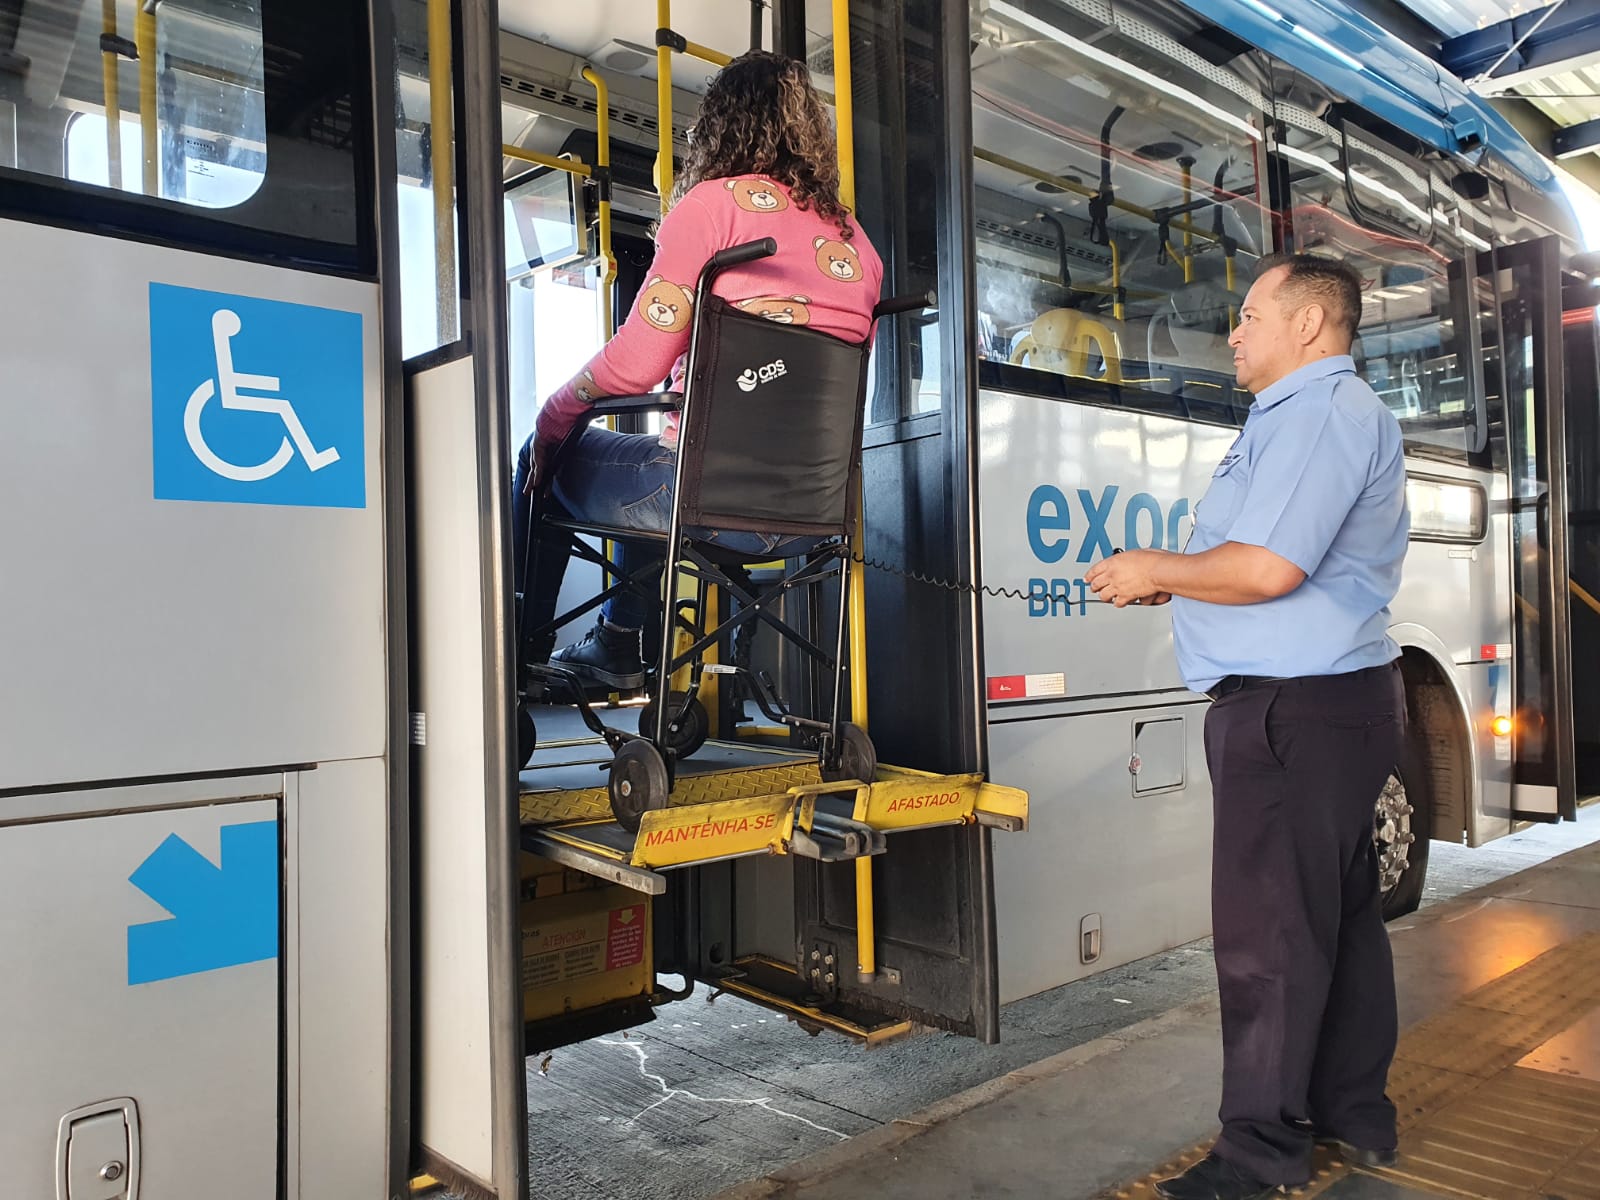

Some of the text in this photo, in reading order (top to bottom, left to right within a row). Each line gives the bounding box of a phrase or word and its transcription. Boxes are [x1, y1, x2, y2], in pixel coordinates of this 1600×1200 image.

[758, 359, 786, 379] CDS
[1028, 578, 1090, 617] BRT
[887, 791, 960, 813] AFASTADO
[645, 813, 776, 847] MANTENHA-SE
